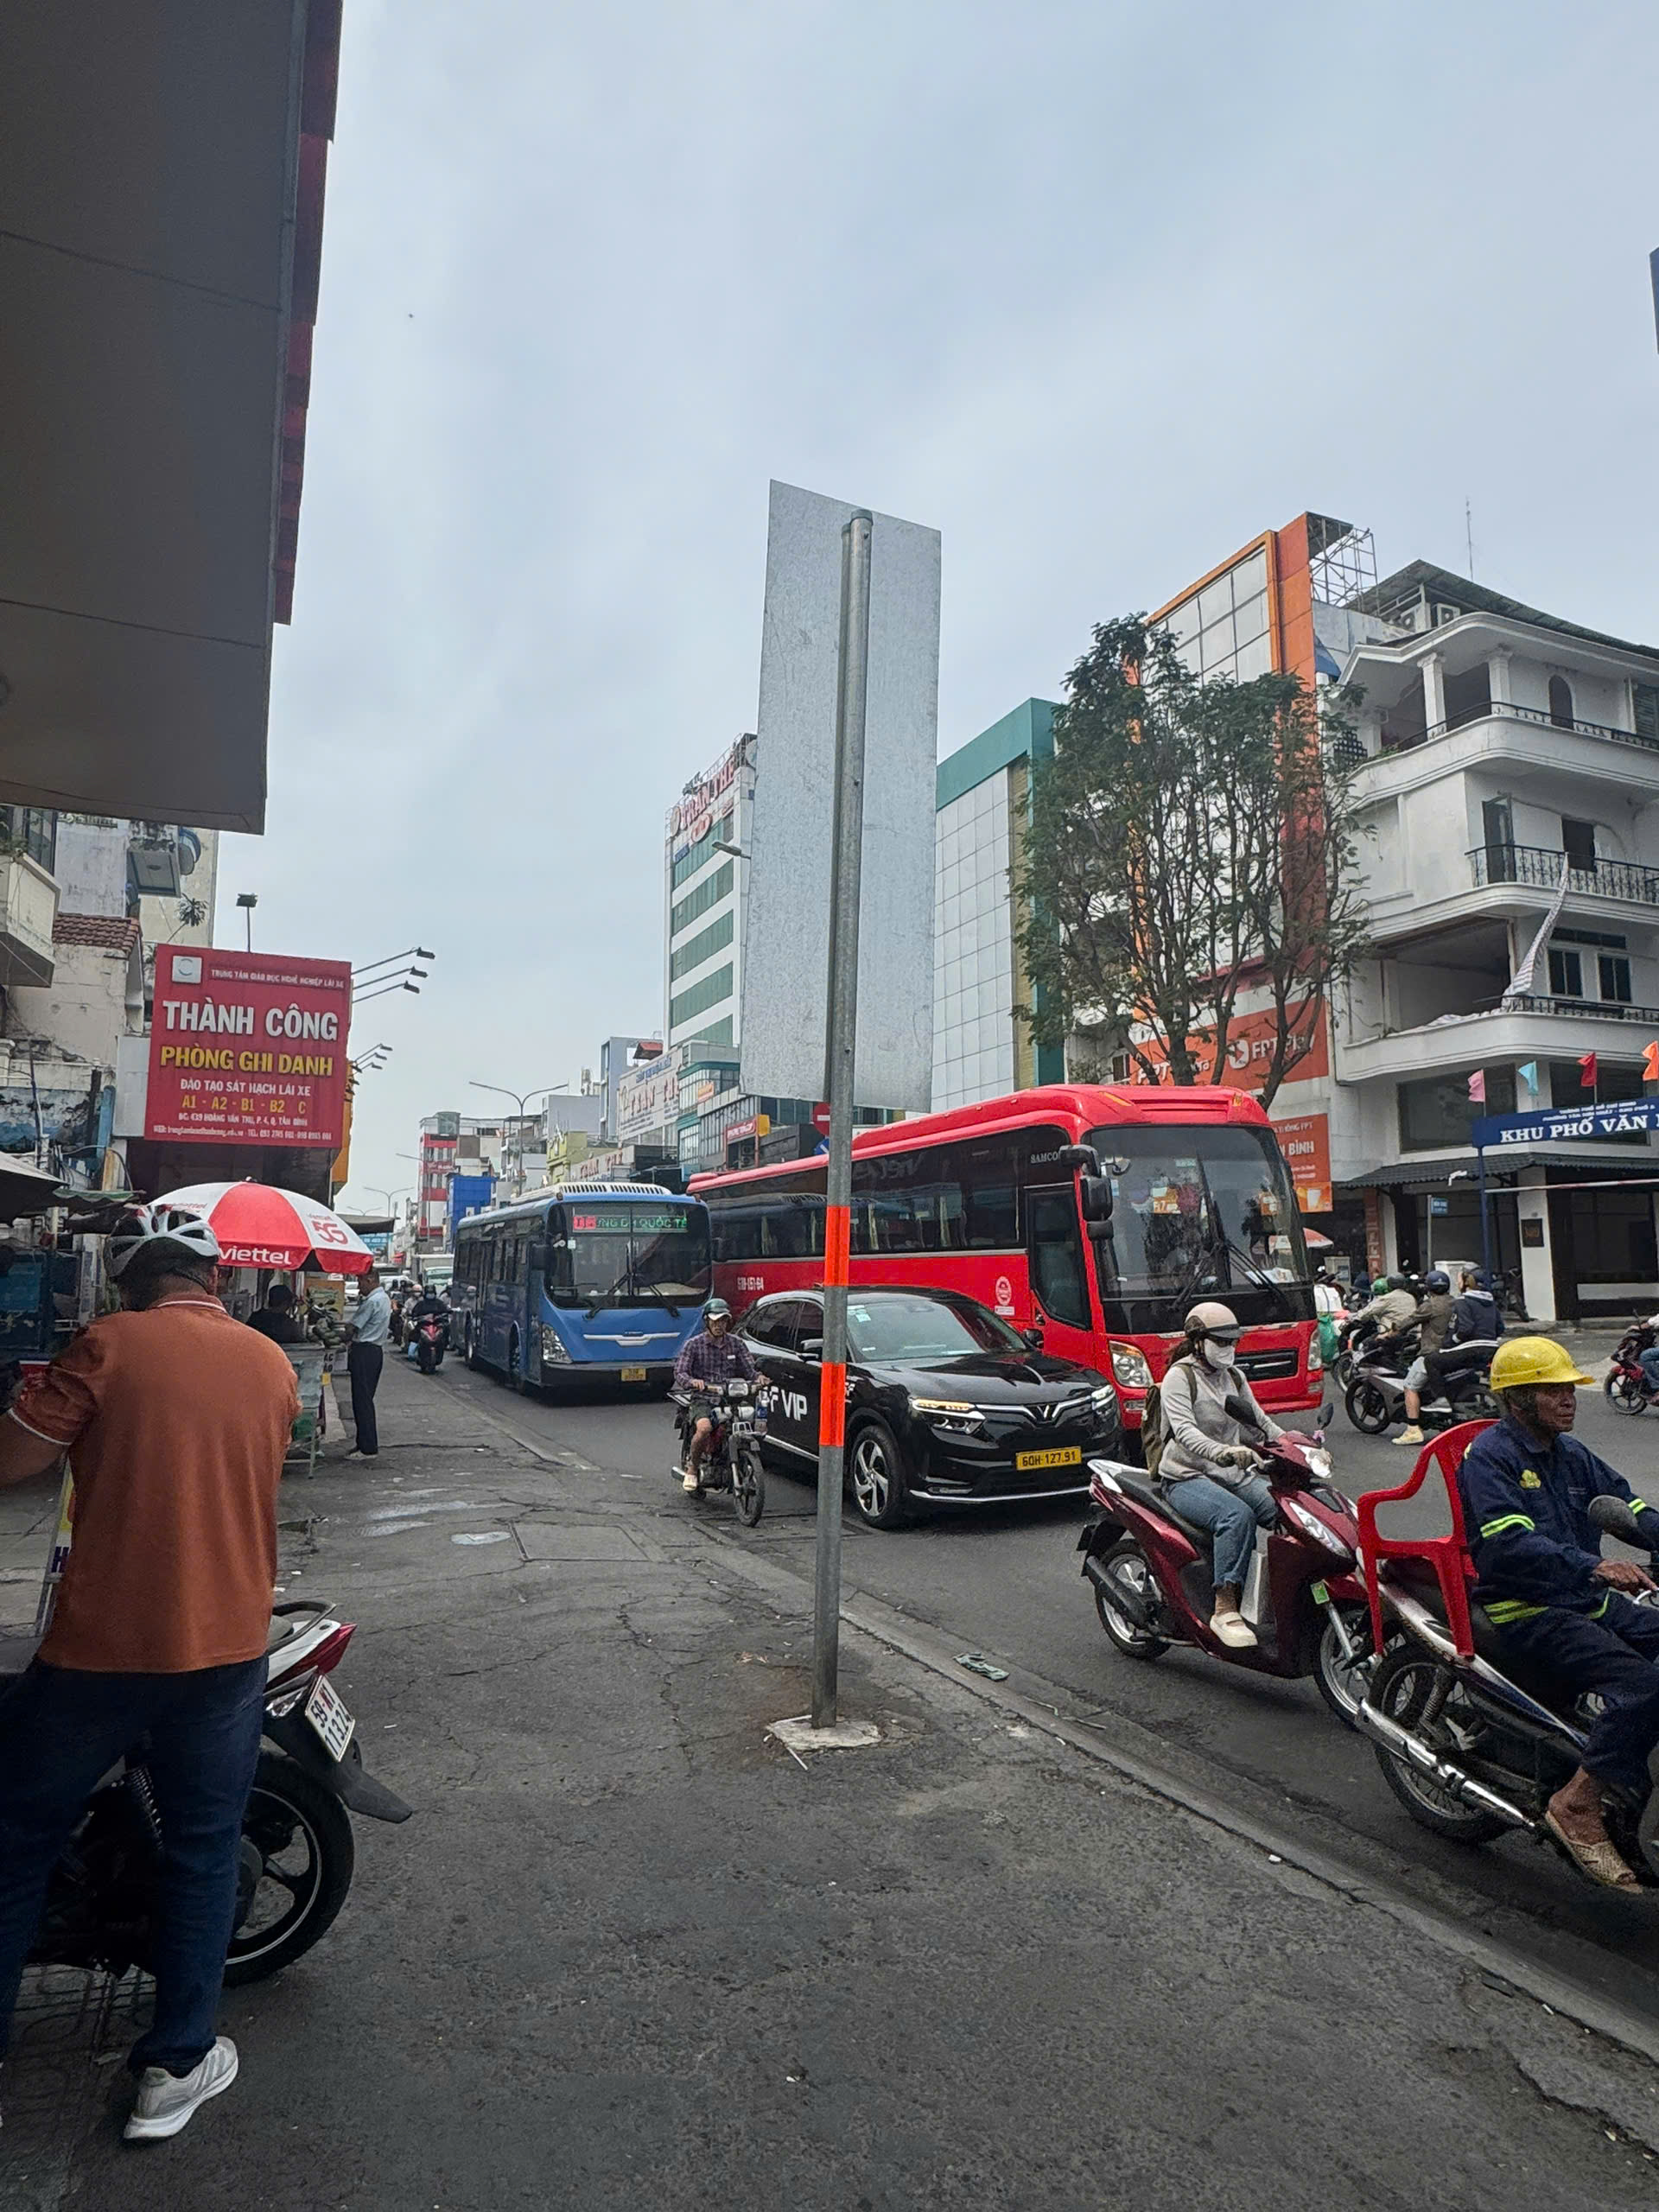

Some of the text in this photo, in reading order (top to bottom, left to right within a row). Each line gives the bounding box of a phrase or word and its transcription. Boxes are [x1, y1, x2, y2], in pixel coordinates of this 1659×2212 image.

[162, 996, 339, 1041] THÀNH CÔNG
[161, 1043, 334, 1077] PHÒNG GHI DANH
[181, 1078, 311, 1096] ĐÀO TẠO SÁT HẠCH LÁI XE
[181, 1095, 307, 1115] A1 A2 B1 B2 C
[1500, 1127, 1544, 1143] KHU
[1550, 1116, 1593, 1138] PHỐ
[1600, 1114, 1649, 1133] VĂN
[1030, 1151, 1058, 1164] SAMCO
[1288, 1140, 1314, 1156] BÌNH
[311, 1219, 348, 1245] 5G
[219, 1245, 292, 1265] viettel
[781, 1389, 808, 1421] VIP
